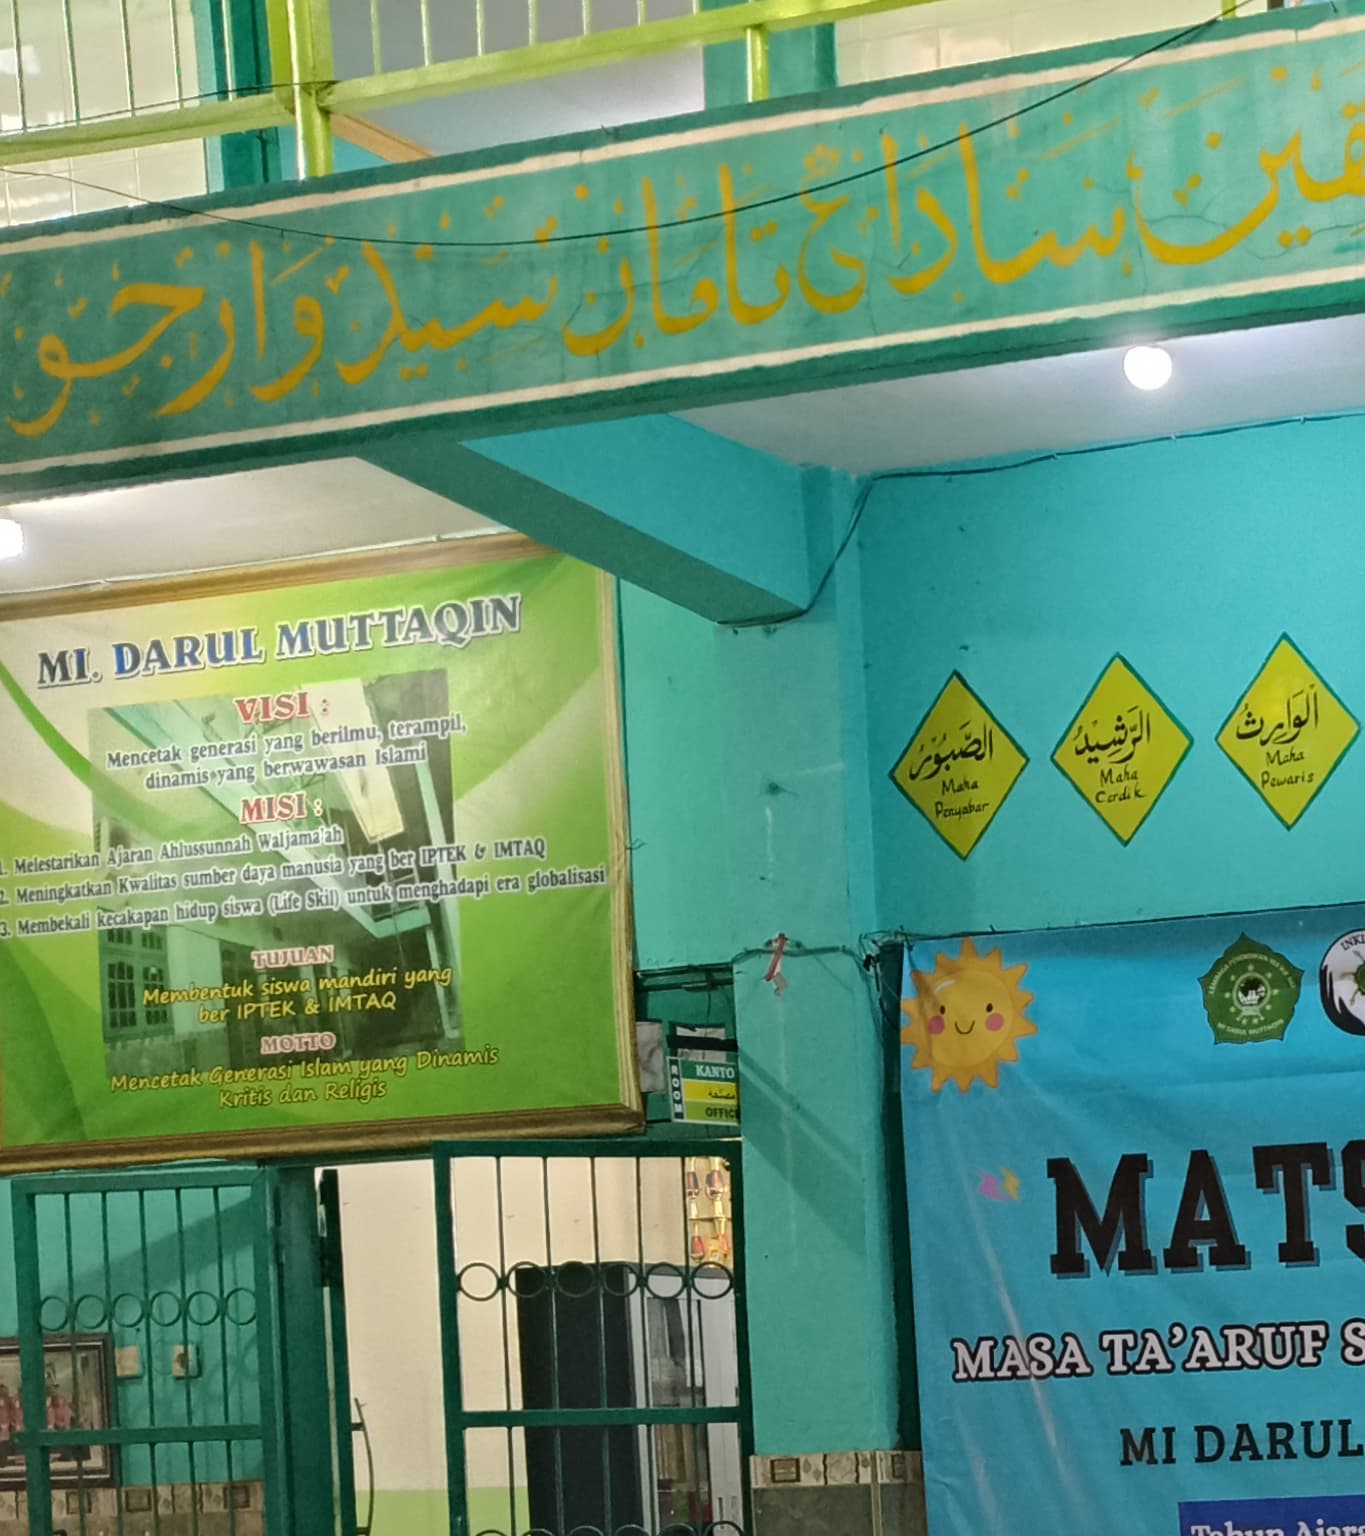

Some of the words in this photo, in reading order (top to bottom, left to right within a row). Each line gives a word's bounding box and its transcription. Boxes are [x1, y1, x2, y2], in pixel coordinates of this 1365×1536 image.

[38, 648, 102, 688] MI.
[112, 627, 265, 679] DARUL
[276, 593, 522, 661] MUTTAQIN
[234, 691, 310, 725] VISI
[107, 745, 182, 769] Mencetak
[191, 739, 257, 761] generasi
[265, 736, 303, 755] yang
[312, 723, 382, 746] berilmu,
[390, 713, 466, 739] terampil,
[1265, 749, 1305, 769] Maha
[145, 767, 209, 789] dinamis
[215, 766, 255, 784] yang
[264, 754, 366, 777] berwawasan
[375, 742, 426, 765] Islami
[1100, 766, 1139, 787] Maha
[1260, 770, 1314, 789] Pewaris
[240, 791, 306, 825] MISI
[14, 851, 100, 875] Melestarikan
[107, 847, 152, 868] Ajaran
[160, 836, 250, 859] Ahlussunnah
[16, 880, 112, 905] Meningkatkan
[118, 876, 177, 894] Kwalitas
[184, 869, 235, 888] sumber
[242, 865, 275, 885] daya
[282, 860, 342, 878] manusia
[350, 856, 383, 875] yang
[390, 850, 415, 868] ber
[421, 845, 466, 865] IPTEK
[494, 838, 546, 859] IMTAQ
[0, 921, 11, 937] 3.
[18, 914, 90, 935] Membekali
[96, 906, 168, 930] kecakapan
[176, 900, 216, 924] hidup
[223, 899, 262, 917] siswa
[268, 893, 301, 916] (Life
[306, 888, 340, 911] Skil)
[347, 886, 391, 904] untuk
[397, 875, 489, 901] menghadapi
[496, 875, 520, 891] era
[528, 864, 606, 892] globalisasi
[251, 945, 334, 969] TUJUAN
[143, 978, 253, 1006] Membentuk
[260, 976, 311, 997] siswa
[319, 967, 397, 991] mandiri
[404, 966, 452, 987] yang
[199, 1002, 230, 1024] ber
[236, 1000, 295, 1020] IPTEK
[304, 998, 320, 1015] &
[329, 993, 397, 1013] IMTAQ
[260, 1032, 337, 1055] MOTTO
[111, 1070, 201, 1092] Mencetak
[208, 1061, 294, 1085] Generasi
[301, 1057, 352, 1079] Islam
[359, 1056, 407, 1077] yang
[416, 1045, 499, 1070] Dinamis
[695, 1064, 736, 1079] KANTO
[218, 1086, 272, 1109] Kritis
[279, 1086, 317, 1104] dan
[325, 1079, 387, 1104] Religis
[953, 1332, 1094, 1383] MASA
[1120, 1427, 1176, 1466] MI
[1194, 1419, 1364, 1463] DARUL
